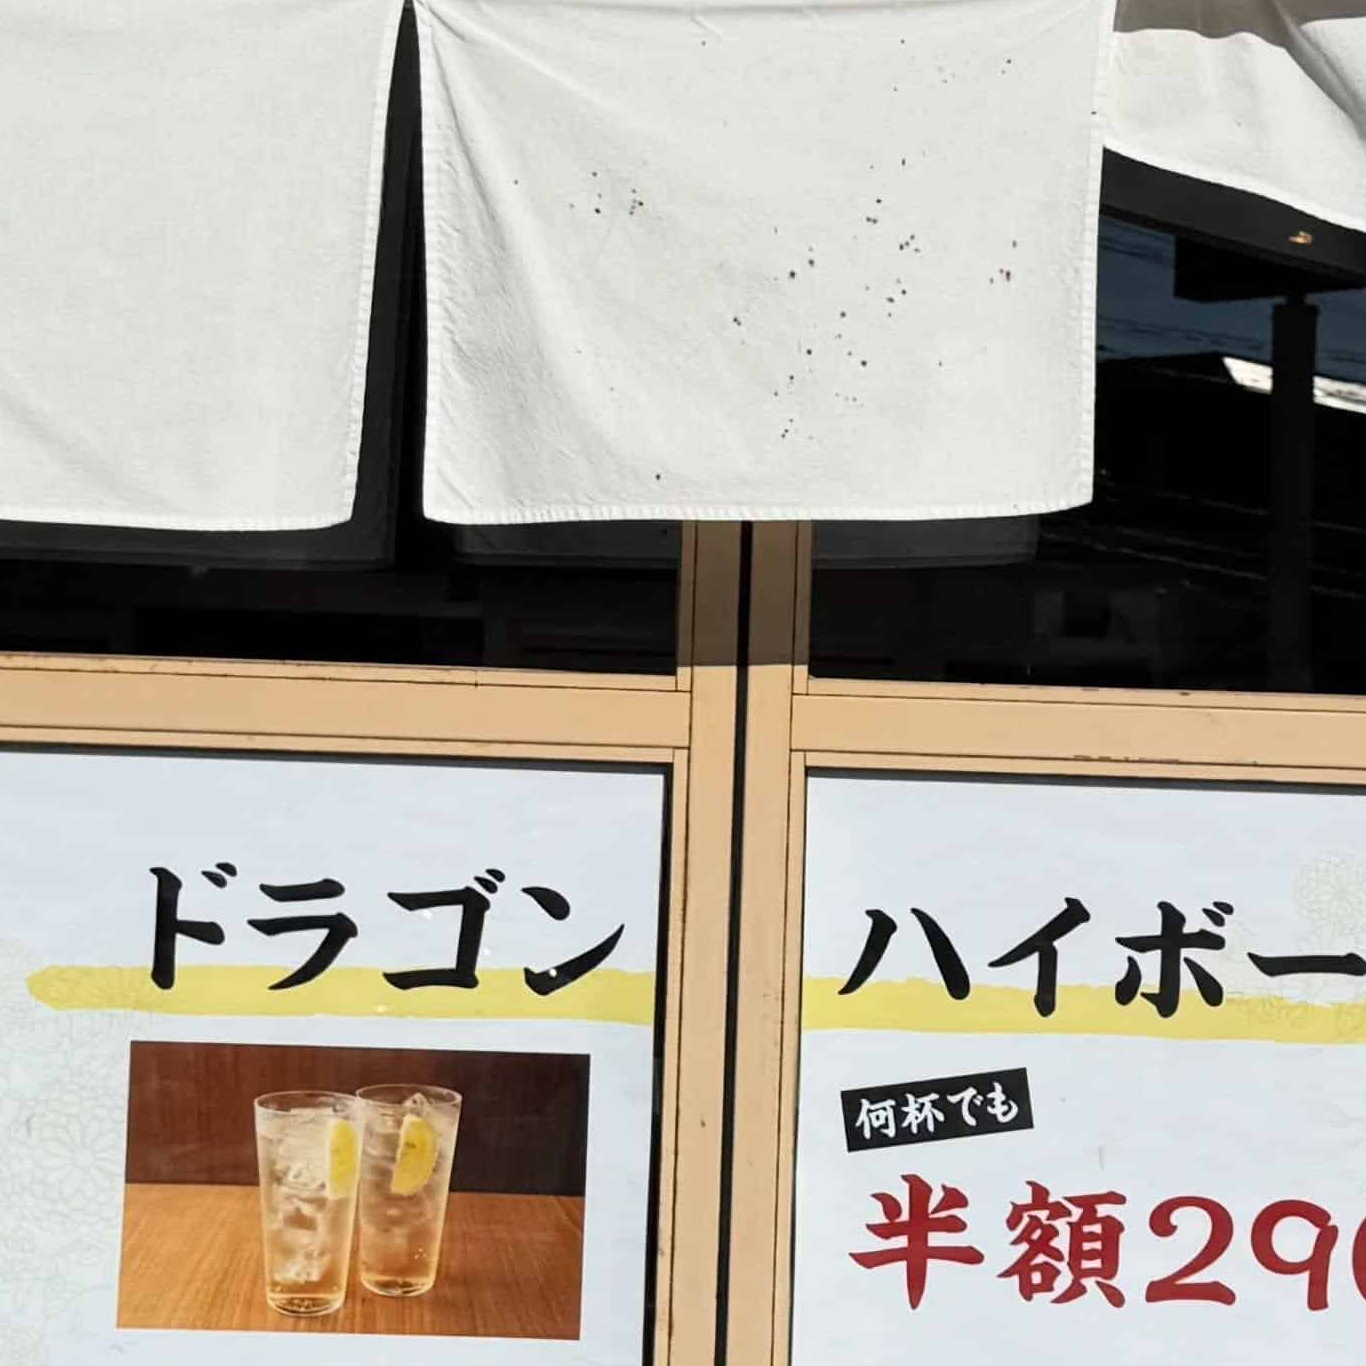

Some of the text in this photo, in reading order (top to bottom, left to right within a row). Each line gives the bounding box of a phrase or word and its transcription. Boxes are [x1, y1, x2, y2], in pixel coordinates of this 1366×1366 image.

[149, 861, 625, 997] ドラゴン
[855, 1081, 1019, 1140] 何杯でも
